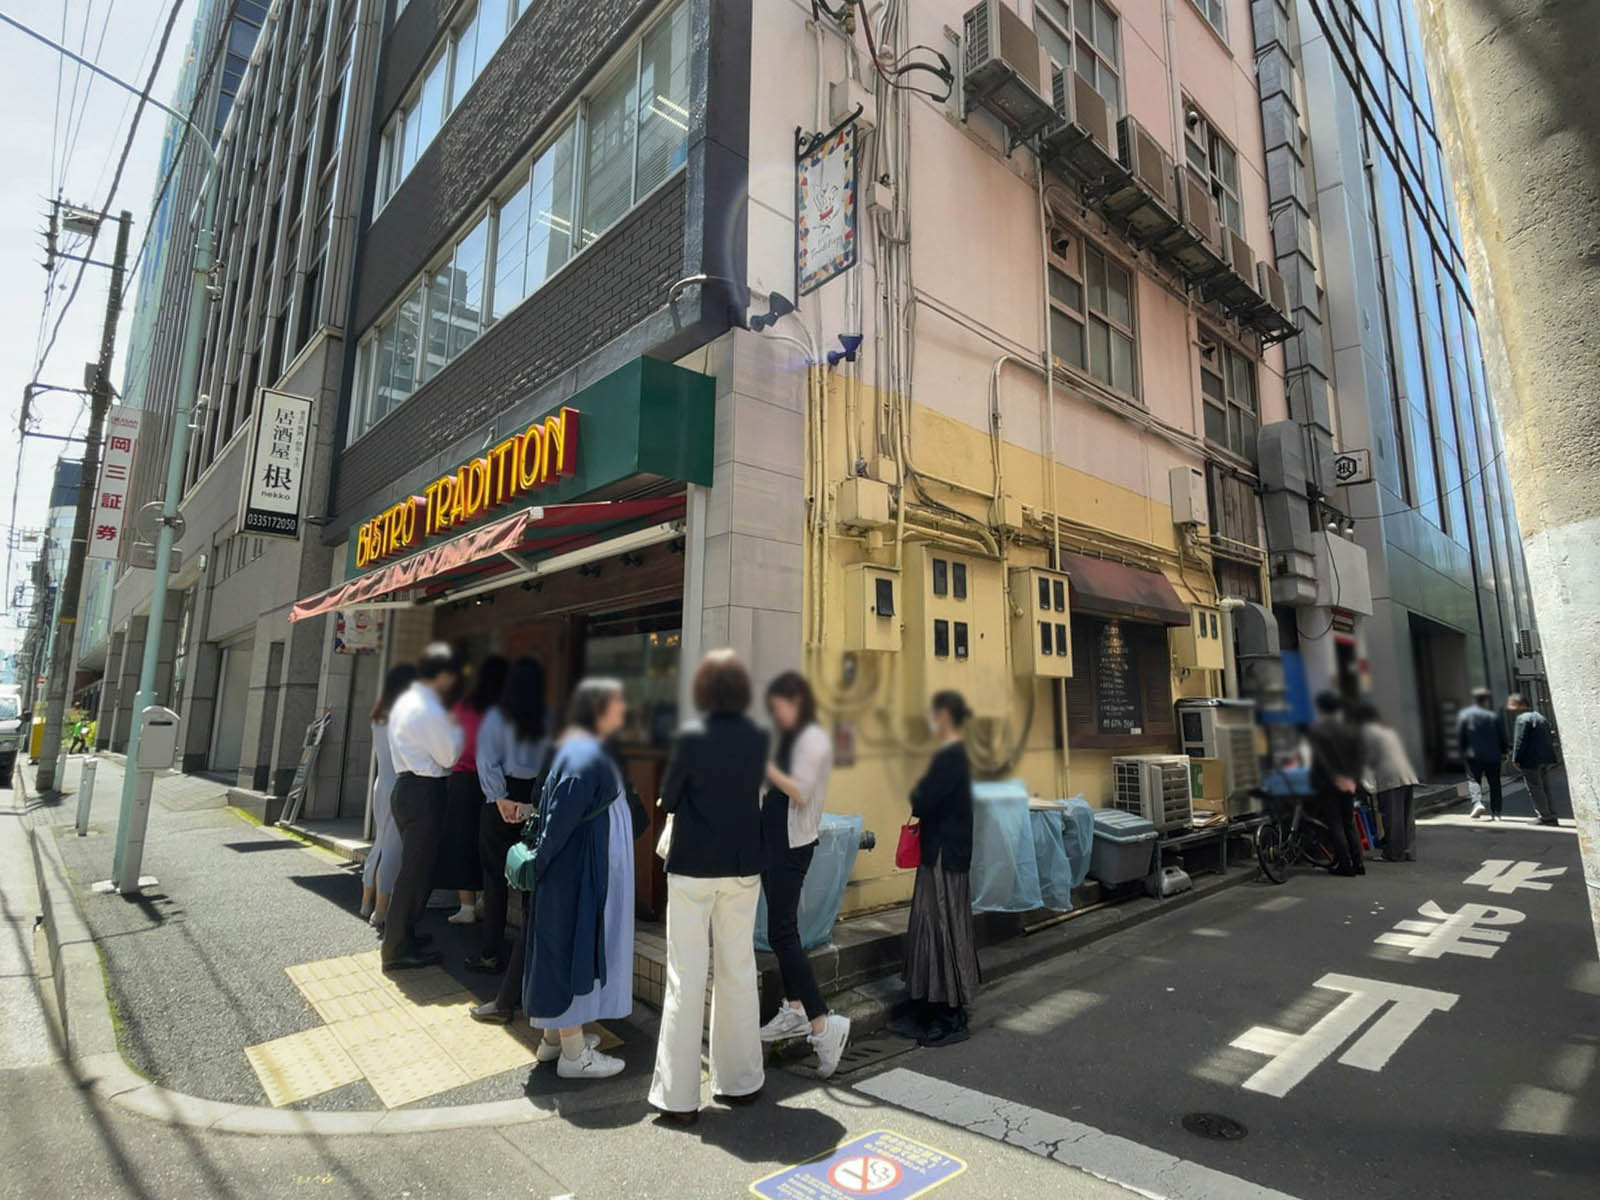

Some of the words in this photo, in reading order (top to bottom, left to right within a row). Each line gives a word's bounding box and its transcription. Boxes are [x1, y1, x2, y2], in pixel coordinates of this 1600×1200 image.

[271, 408, 295, 460] 居酒屋
[96, 436, 131, 541] 岡三証券
[261, 491, 291, 501] nekko
[262, 463, 292, 491] 根
[356, 496, 424, 567] BISTRO
[424, 407, 577, 536] TRADITION
[247, 513, 296, 531] 0335172050
[1228, 859, 1568, 1098] 止まれ
